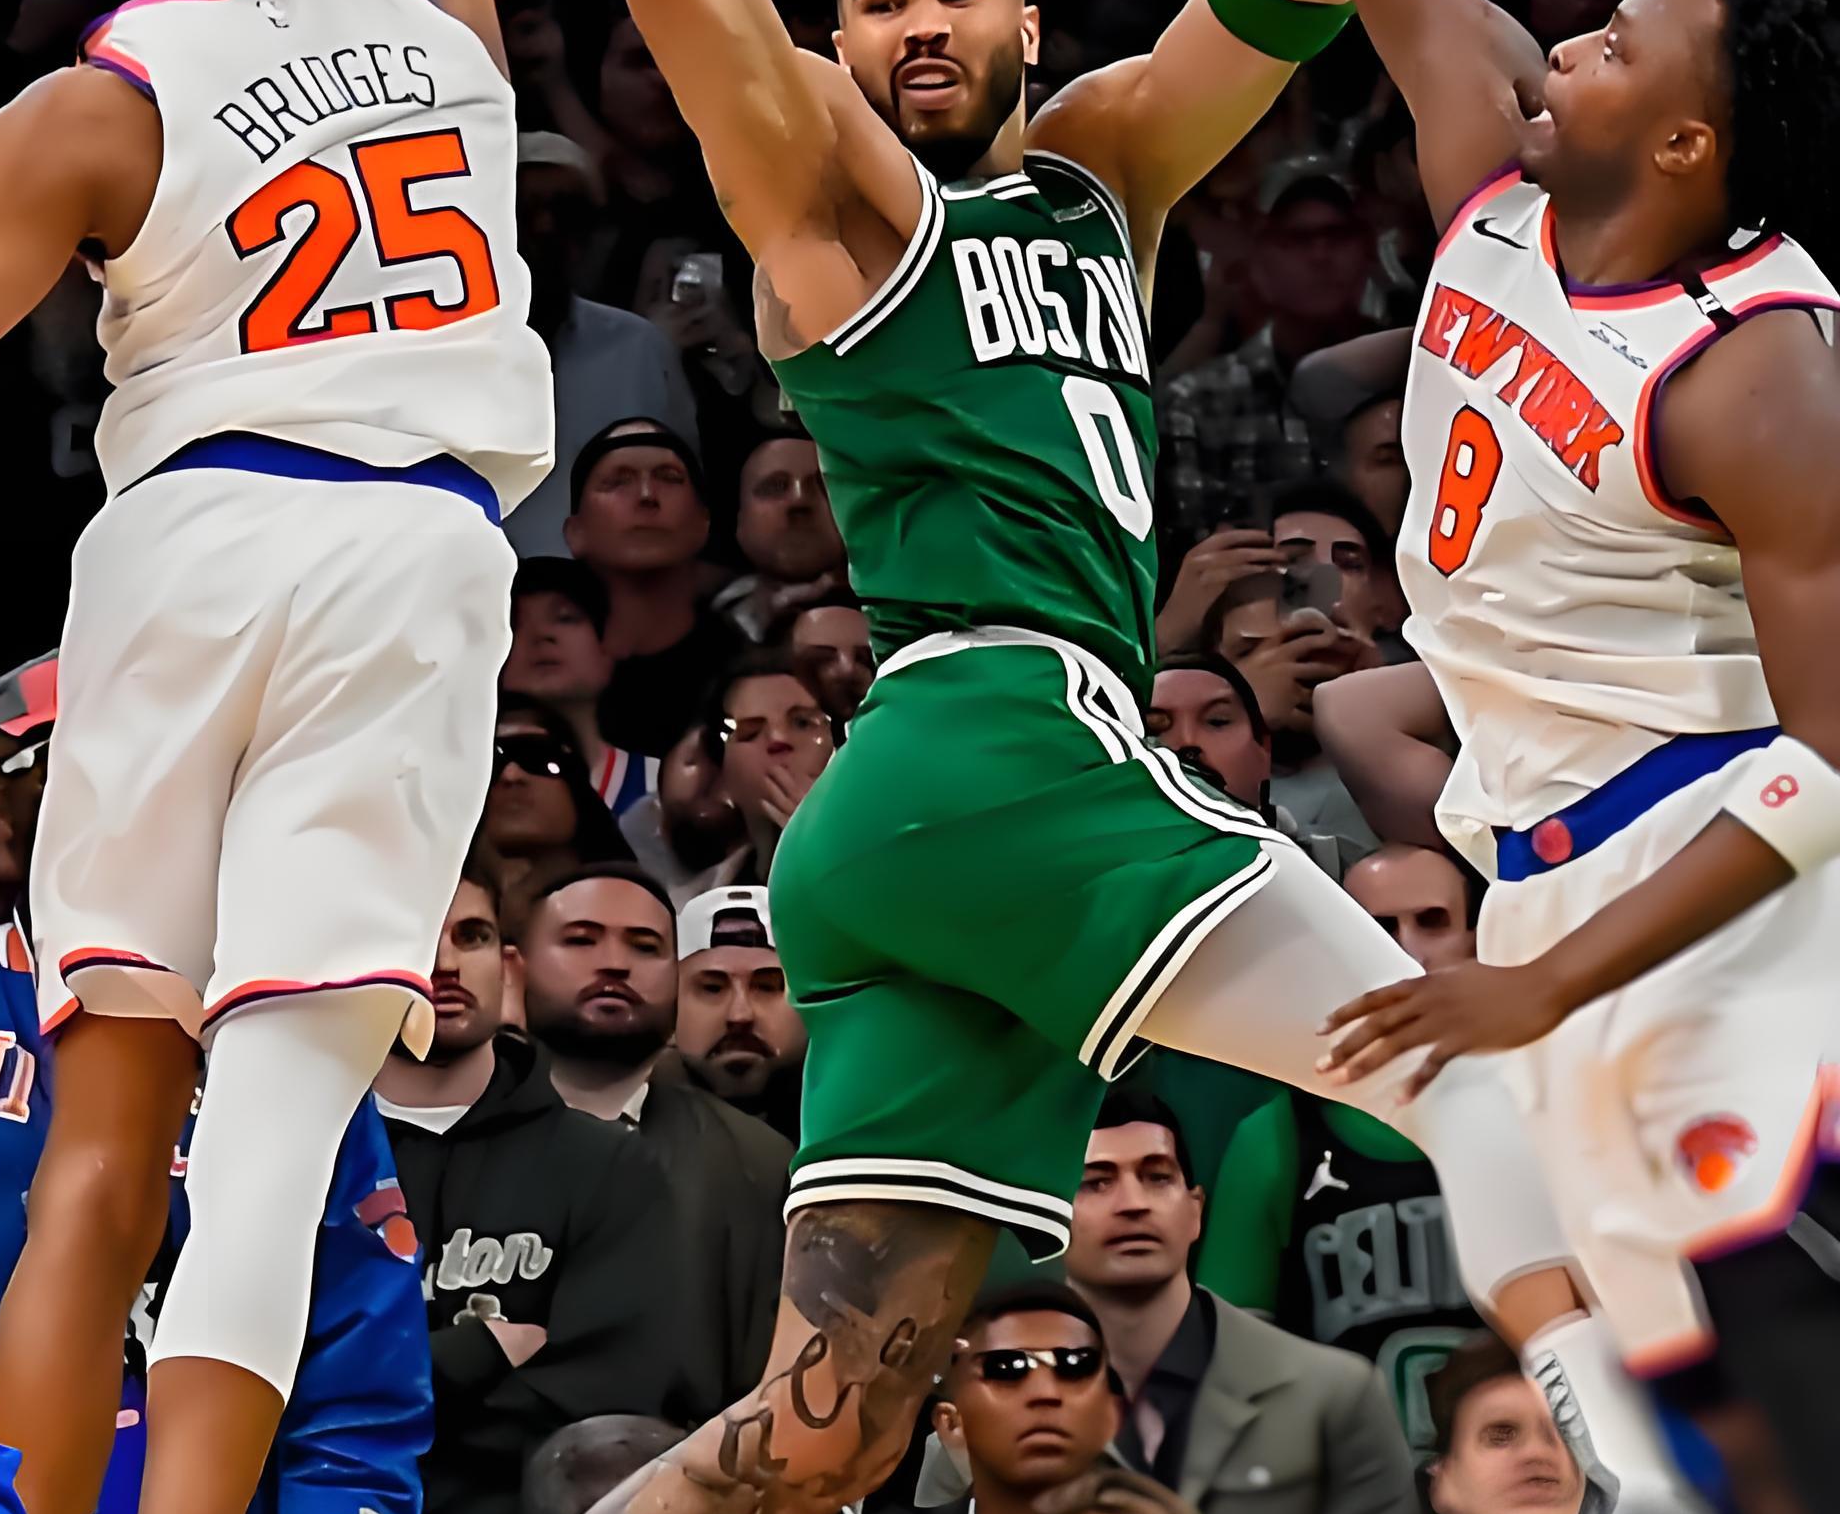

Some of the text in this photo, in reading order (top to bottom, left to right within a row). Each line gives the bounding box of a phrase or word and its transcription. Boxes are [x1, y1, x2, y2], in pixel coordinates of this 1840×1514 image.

[213, 43, 436, 164] BRIDGES
[224, 126, 501, 355] 25
[1060, 375, 1154, 542] 0
[1428, 402, 1503, 571] 8
[1759, 773, 1800, 809] 8
